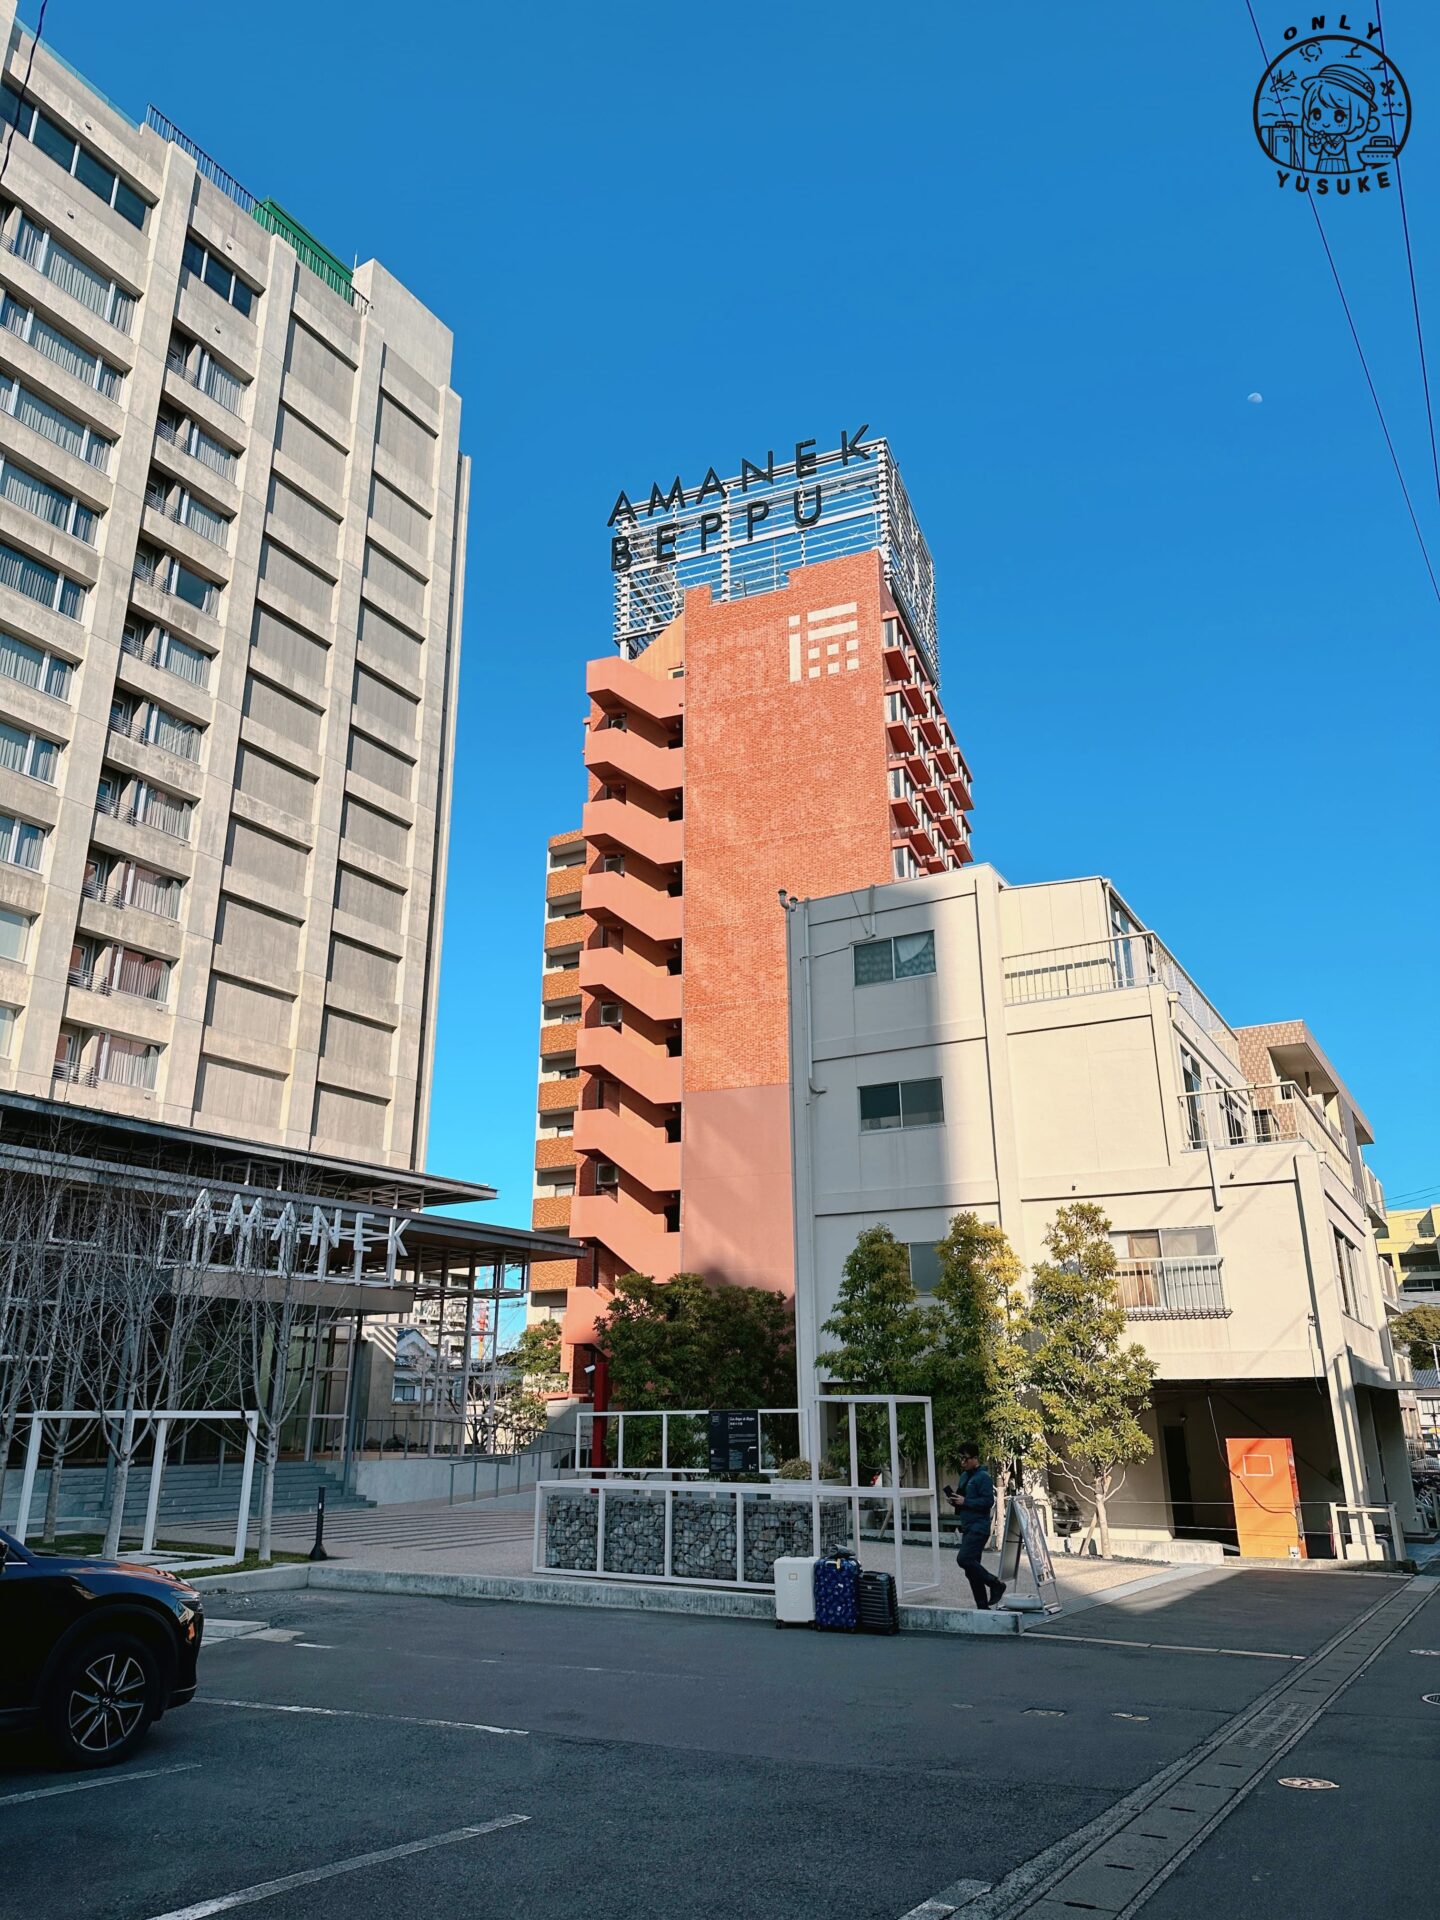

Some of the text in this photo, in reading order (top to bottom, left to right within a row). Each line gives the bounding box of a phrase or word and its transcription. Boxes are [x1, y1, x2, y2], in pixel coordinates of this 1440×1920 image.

[607, 423, 870, 527] AMANEK
[611, 485, 822, 571] BEPPU
[183, 1188, 411, 1257] AMANEK
